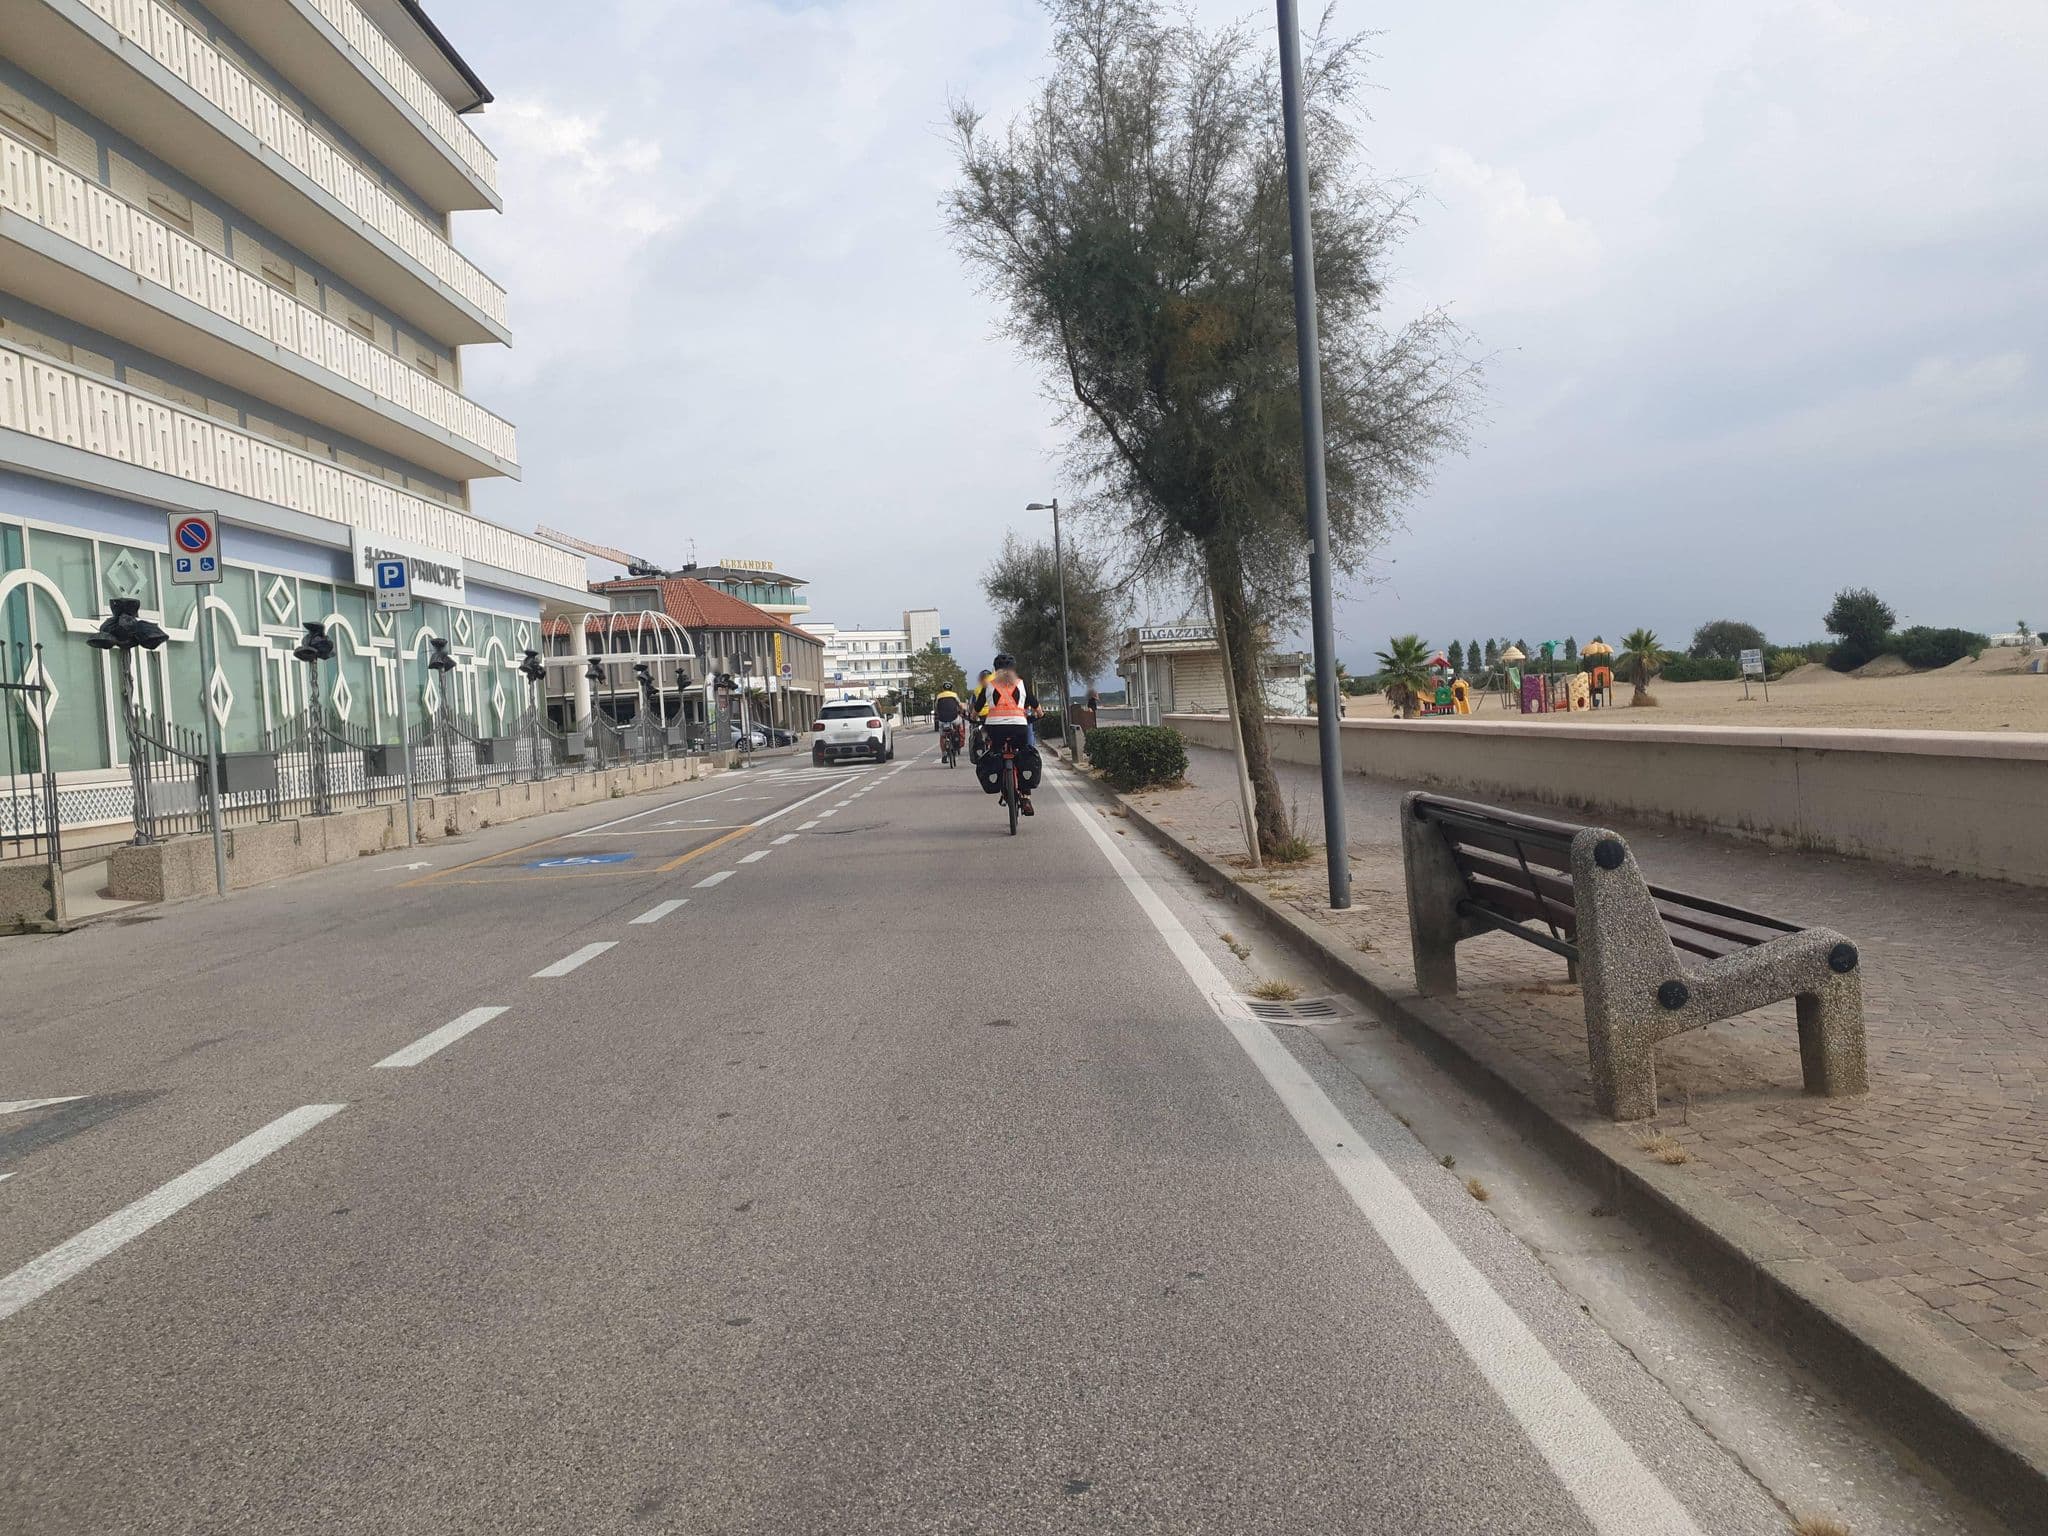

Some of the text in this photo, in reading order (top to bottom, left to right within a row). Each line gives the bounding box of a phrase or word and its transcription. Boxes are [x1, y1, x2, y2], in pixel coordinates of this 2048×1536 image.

[180, 560, 188, 571] P
[720, 559, 774, 570] ALEXANDER
[383, 566, 399, 586] P
[410, 557, 462, 590] PRINCIPE
[1141, 629, 1156, 640] IL
